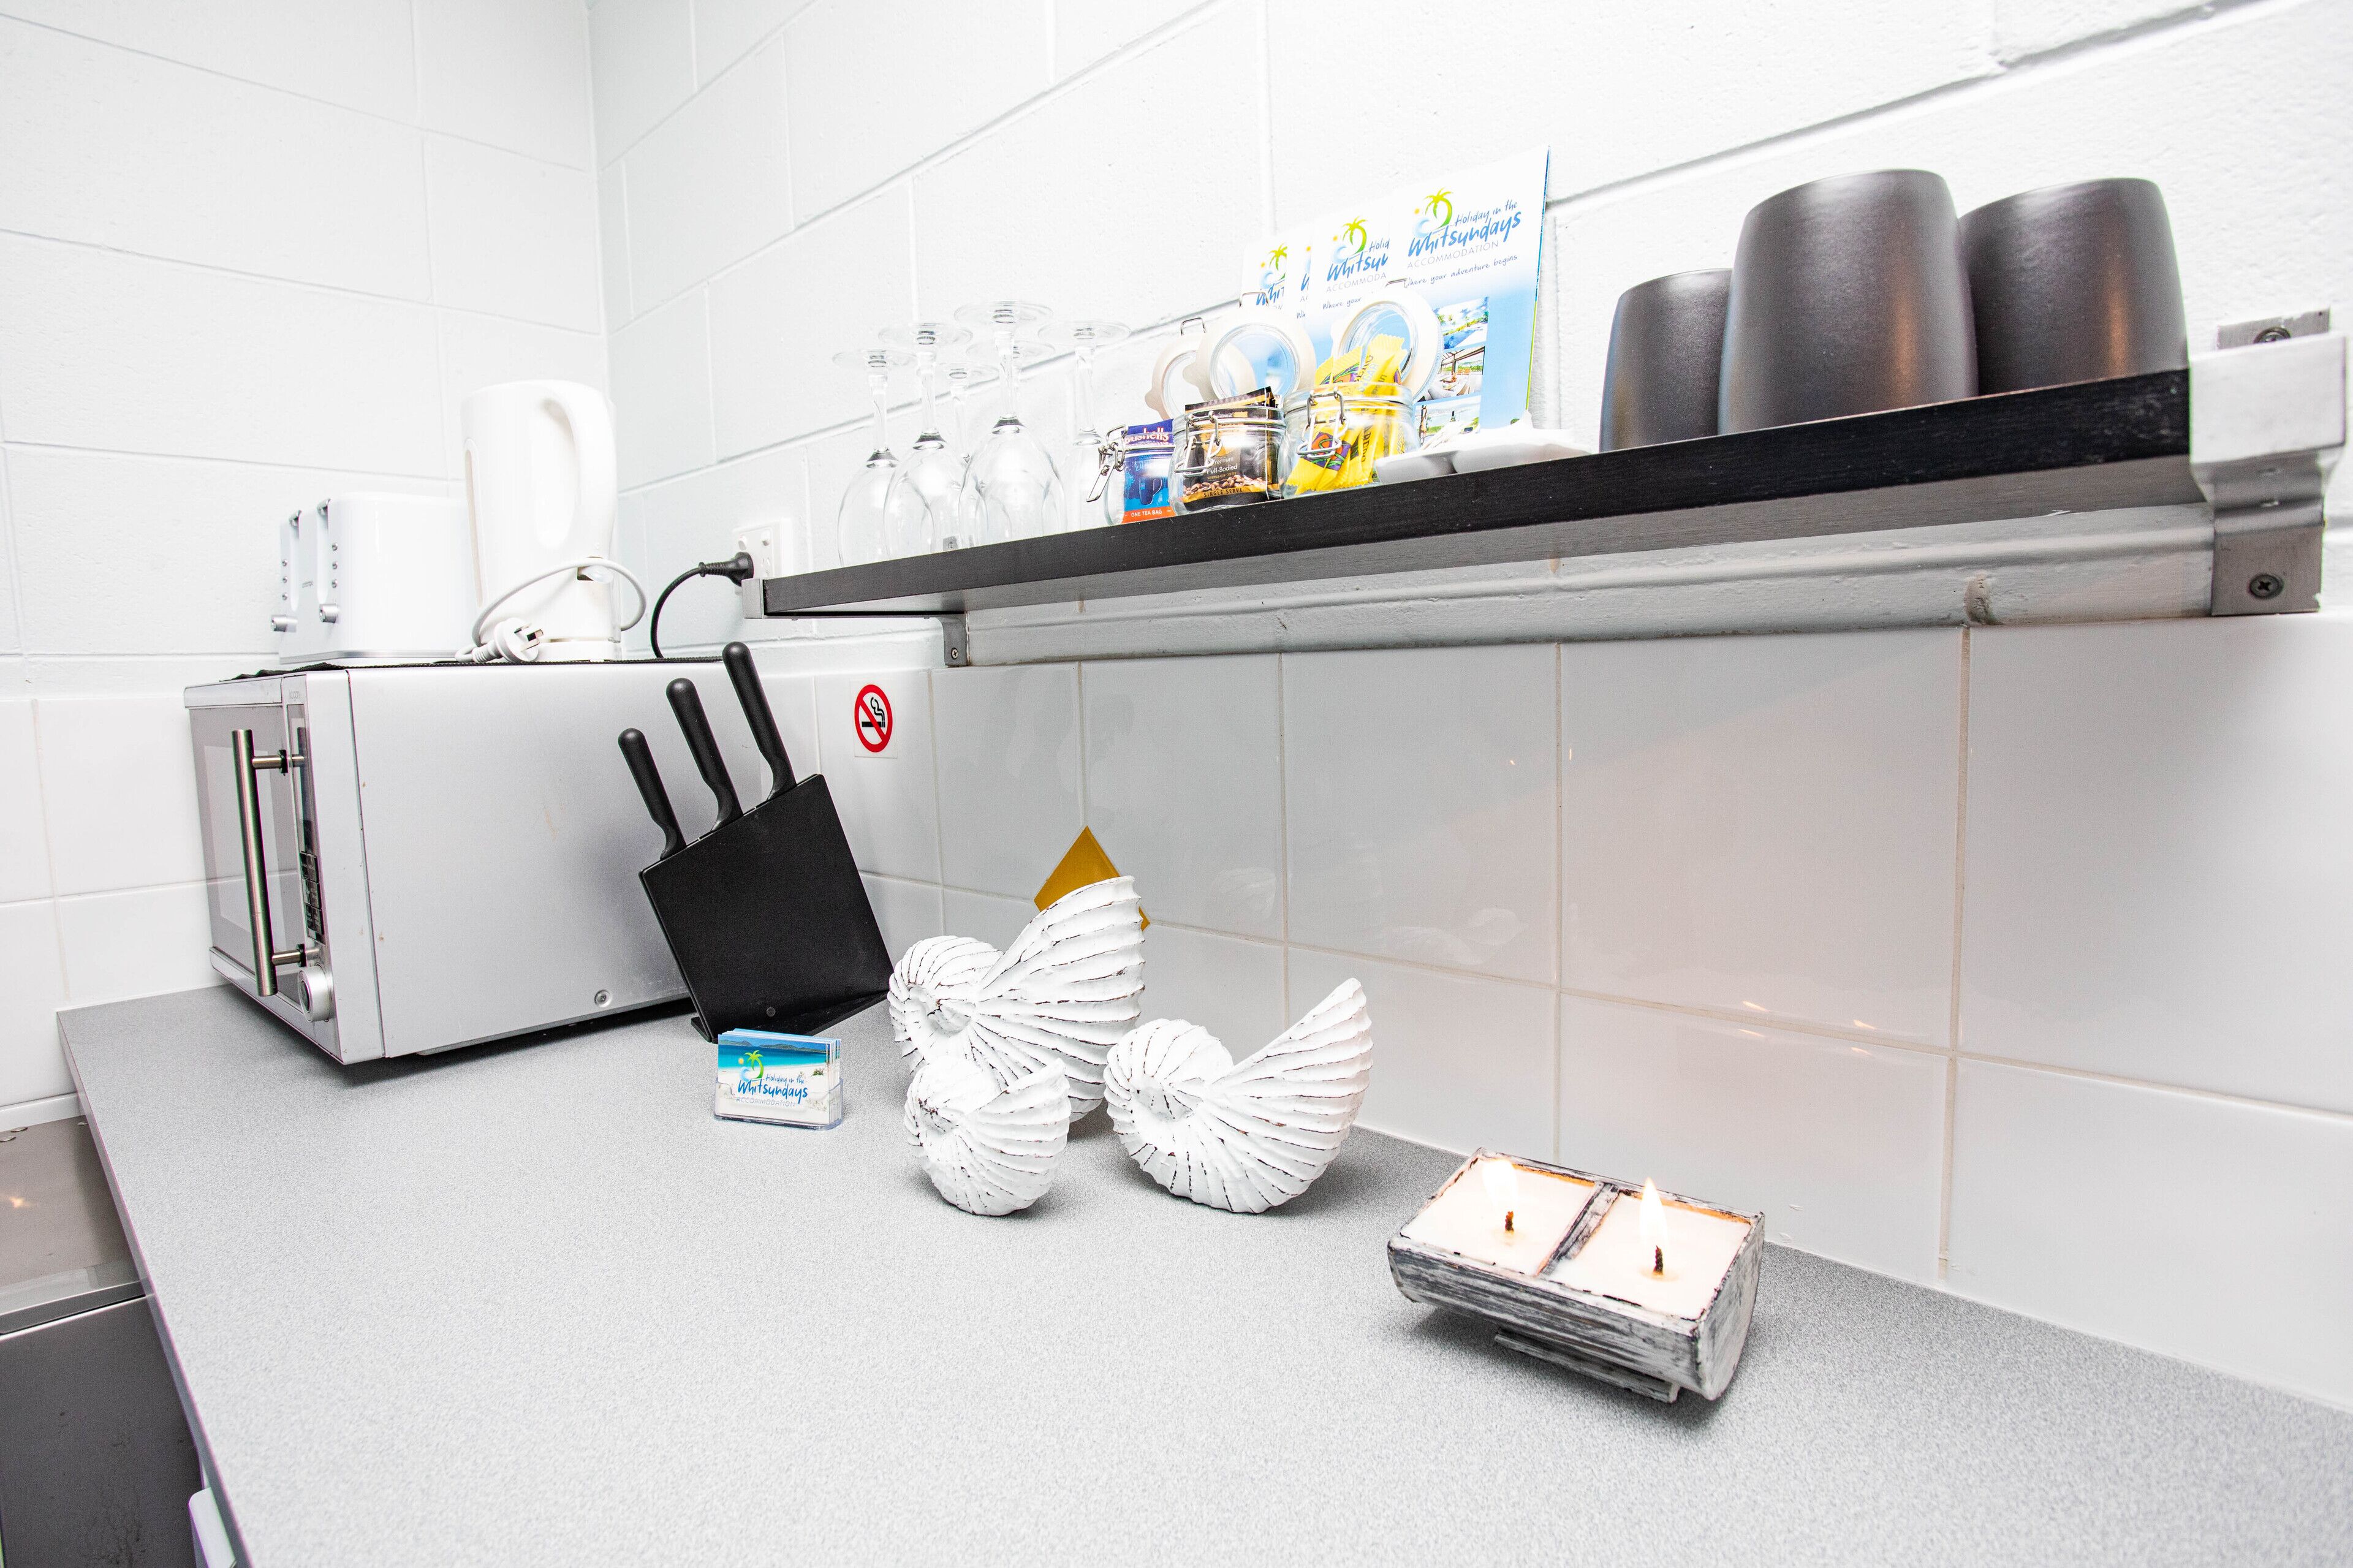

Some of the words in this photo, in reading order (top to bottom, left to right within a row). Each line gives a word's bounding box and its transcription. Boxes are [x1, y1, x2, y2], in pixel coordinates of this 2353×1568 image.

[1455, 211, 1490, 226] Holiday
[1505, 200, 1517, 211] the
[1408, 211, 1521, 257] Whitsundays
[1407, 240, 1499, 268] ACCOMMODATION
[1326, 273, 1387, 292] ACCOMMODA
[1431, 273, 1447, 284] your
[1450, 264, 1490, 277] adventure
[1494, 255, 1518, 266] begins
[1322, 301, 1343, 309] Where
[1347, 297, 1362, 306] your
[1207, 463, 1238, 474] Full-Bodied
[737, 1078, 808, 1104] Whitsundays
[766, 1074, 787, 1086] Holiday
